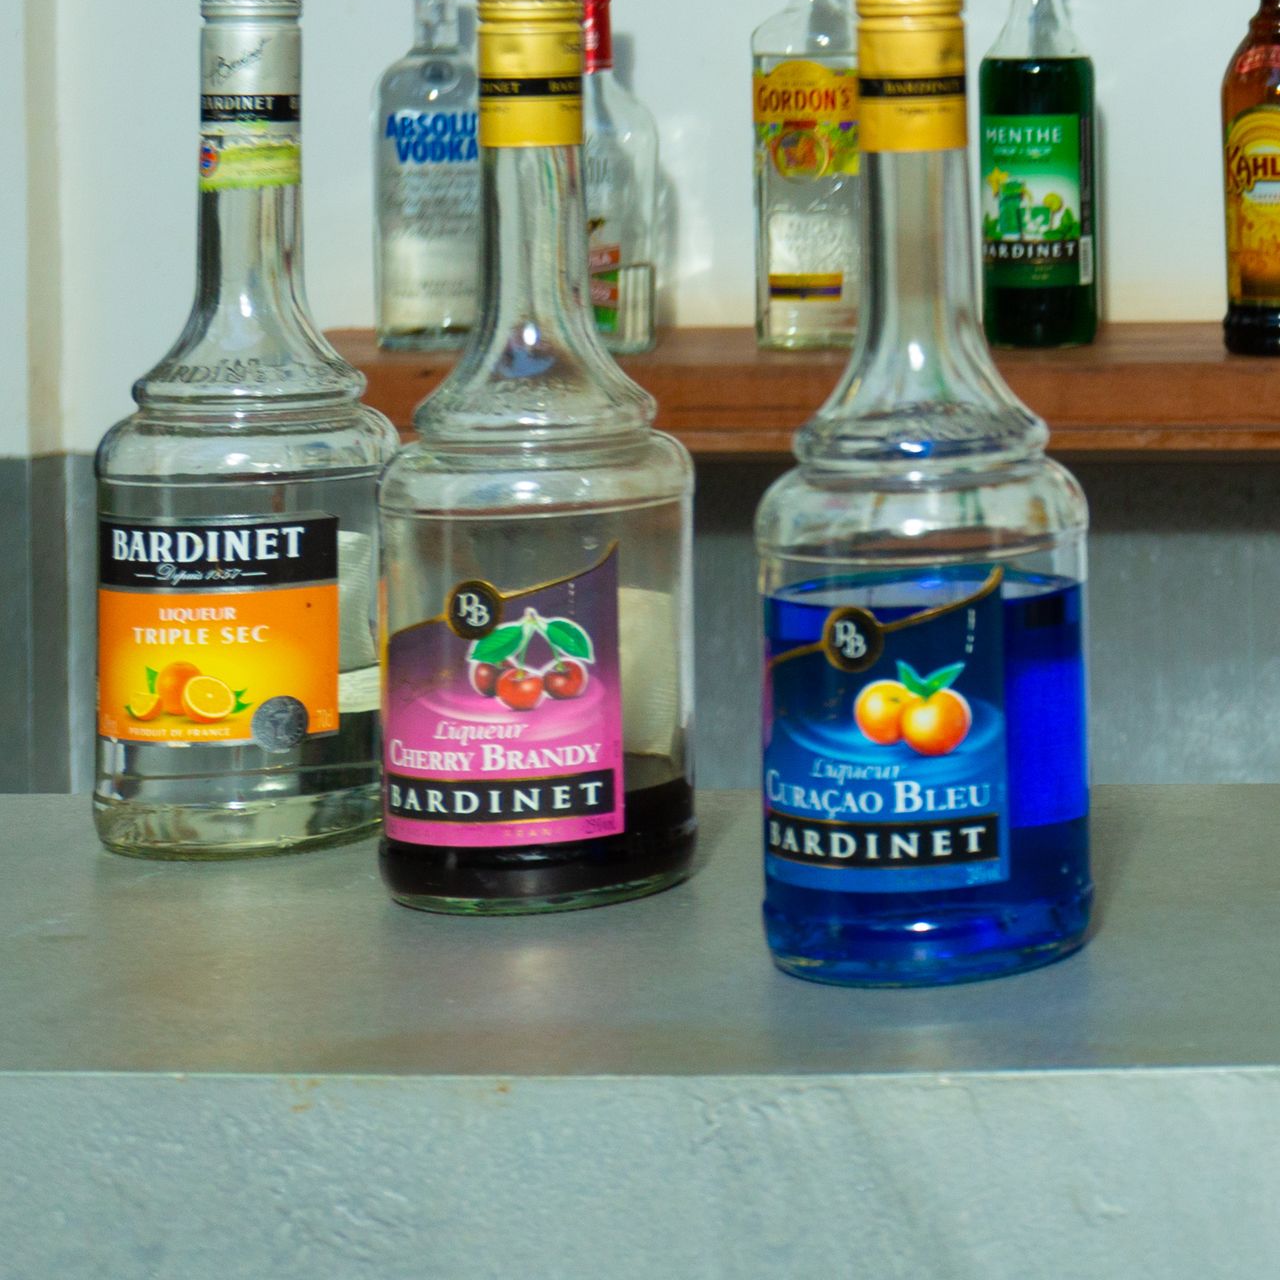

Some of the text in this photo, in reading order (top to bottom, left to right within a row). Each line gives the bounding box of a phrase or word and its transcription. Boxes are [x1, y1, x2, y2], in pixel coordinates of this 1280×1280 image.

[757, 85, 851, 113] GORDON'S
[386, 112, 477, 138] ABSOLU
[986, 126, 1062, 144] MENTHE
[396, 137, 479, 164] VODKA
[112, 526, 305, 563] BARDINET
[158, 606, 237, 624] LIQUEUR
[132, 624, 270, 645] TRIPLE SEC
[433, 721, 529, 747] Liqueur
[389, 739, 602, 771] CHERRY BRANDY
[810, 758, 901, 785] Liqueur
[390, 781, 603, 815] BARDINET
[893, 780, 991, 813] BLEU
[769, 821, 987, 859] BARDINET
